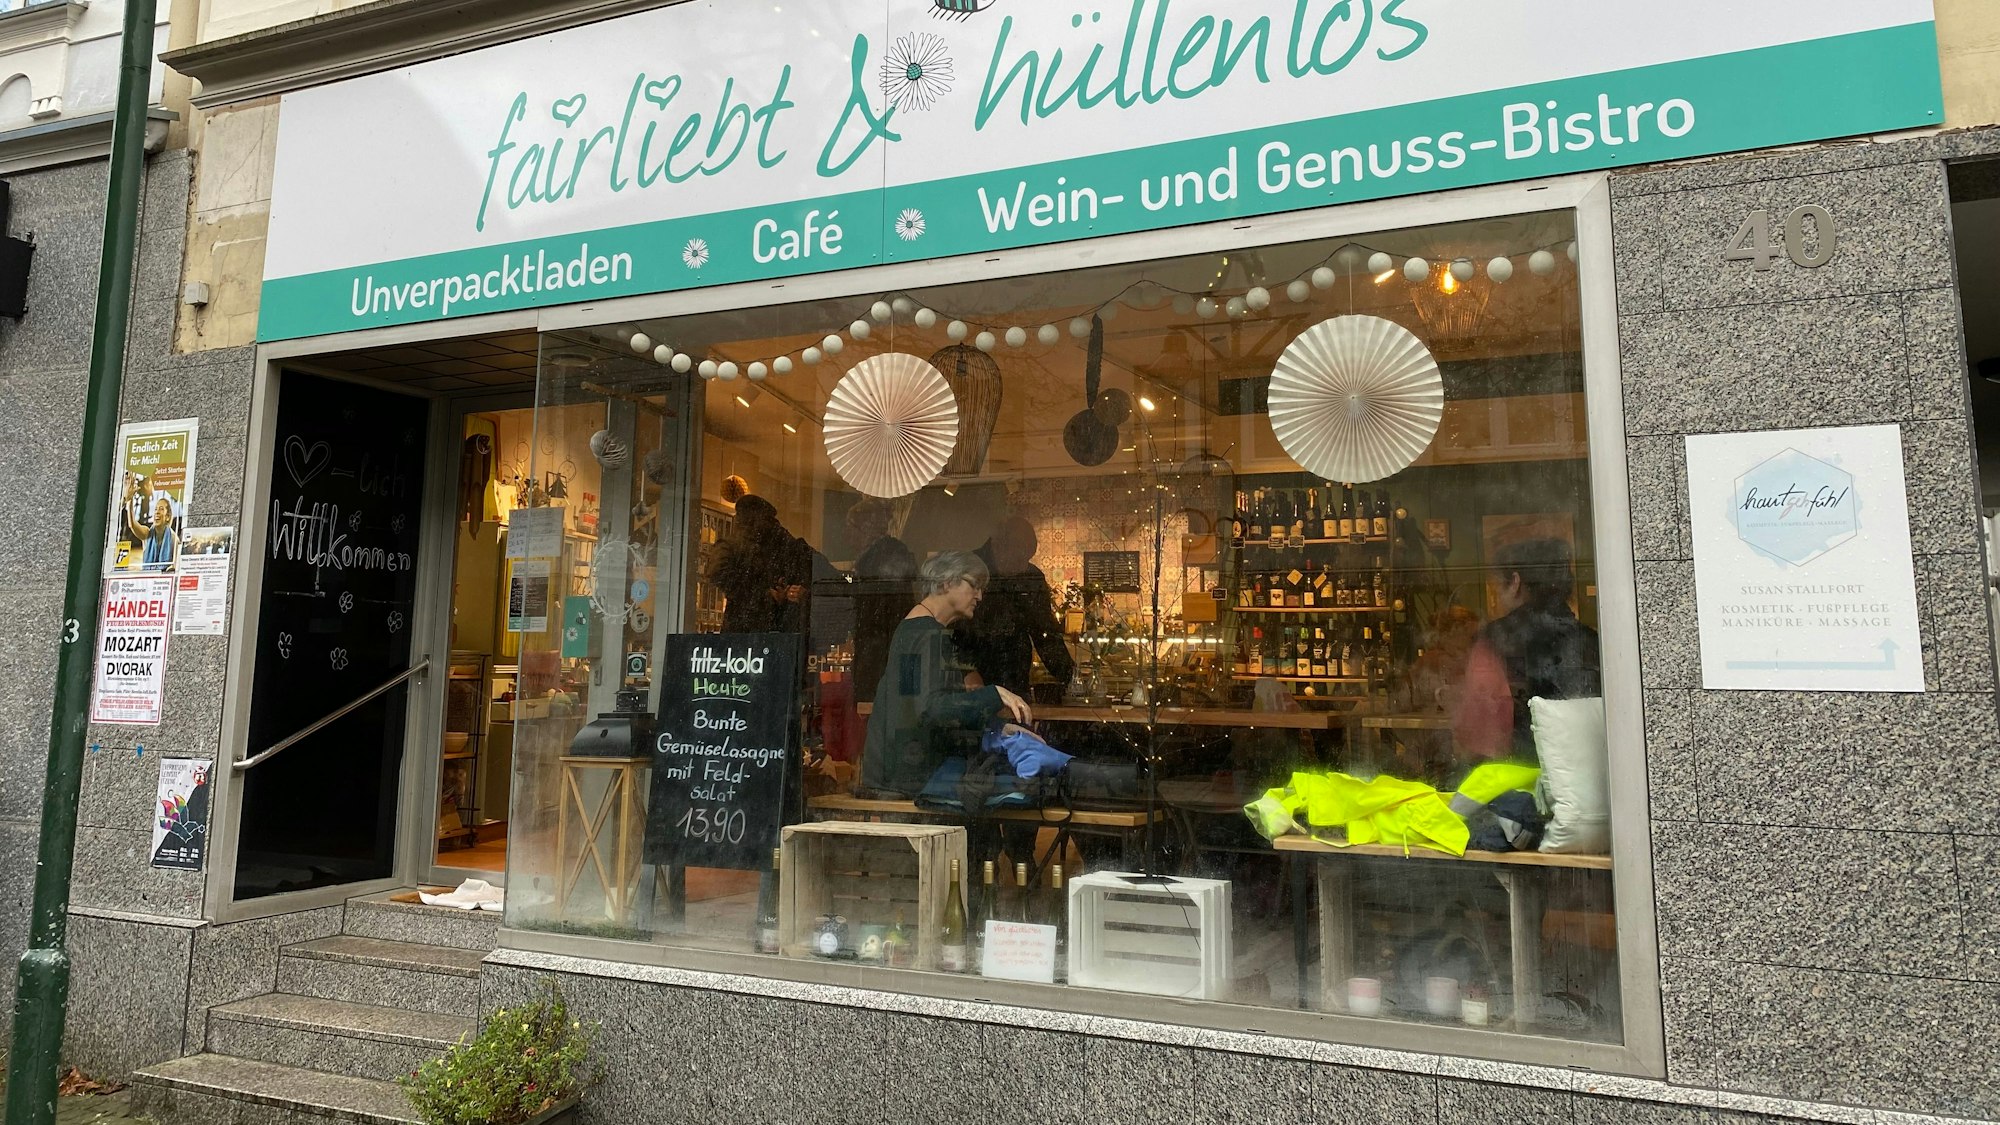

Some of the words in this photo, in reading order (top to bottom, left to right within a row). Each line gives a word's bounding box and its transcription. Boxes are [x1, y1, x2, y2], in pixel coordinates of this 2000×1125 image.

[475, 64, 797, 232] fairliebt
[816, 33, 902, 177] &
[975, 0, 1428, 131] hüllenlos
[350, 243, 634, 317] Unverpacktladen
[752, 209, 844, 265] Café
[977, 178, 1124, 235] Wein-
[1141, 146, 1238, 212] und
[1257, 93, 1696, 195] Genuss-Bistro
[1725, 204, 1836, 273] 40
[131, 440, 160, 453] Endlich
[161, 439, 178, 450] Zeit
[130, 456, 140, 466] für
[141, 454, 160, 465] Mich!
[1741, 585, 1783, 595] SUSAN
[1787, 584, 1864, 595] STALLFORT
[106, 596, 167, 618] HÄNDEL
[1721, 604, 1795, 614] KOSMETIK
[1807, 603, 1889, 613] FUßPFLEGE
[64, 618, 80, 643] 3
[1722, 616, 1804, 627] MANIKÜRE
[1818, 617, 1892, 627] MASSAGE
[104, 636, 162, 652] MOZART
[106, 662, 153, 676] DVORAK
[693, 677, 751, 697] Heute
[693, 709, 748, 731] Bunte
[667, 758, 694, 780] mit
[703, 759, 751, 784] Feld-
[676, 807, 747, 844] 13,90
